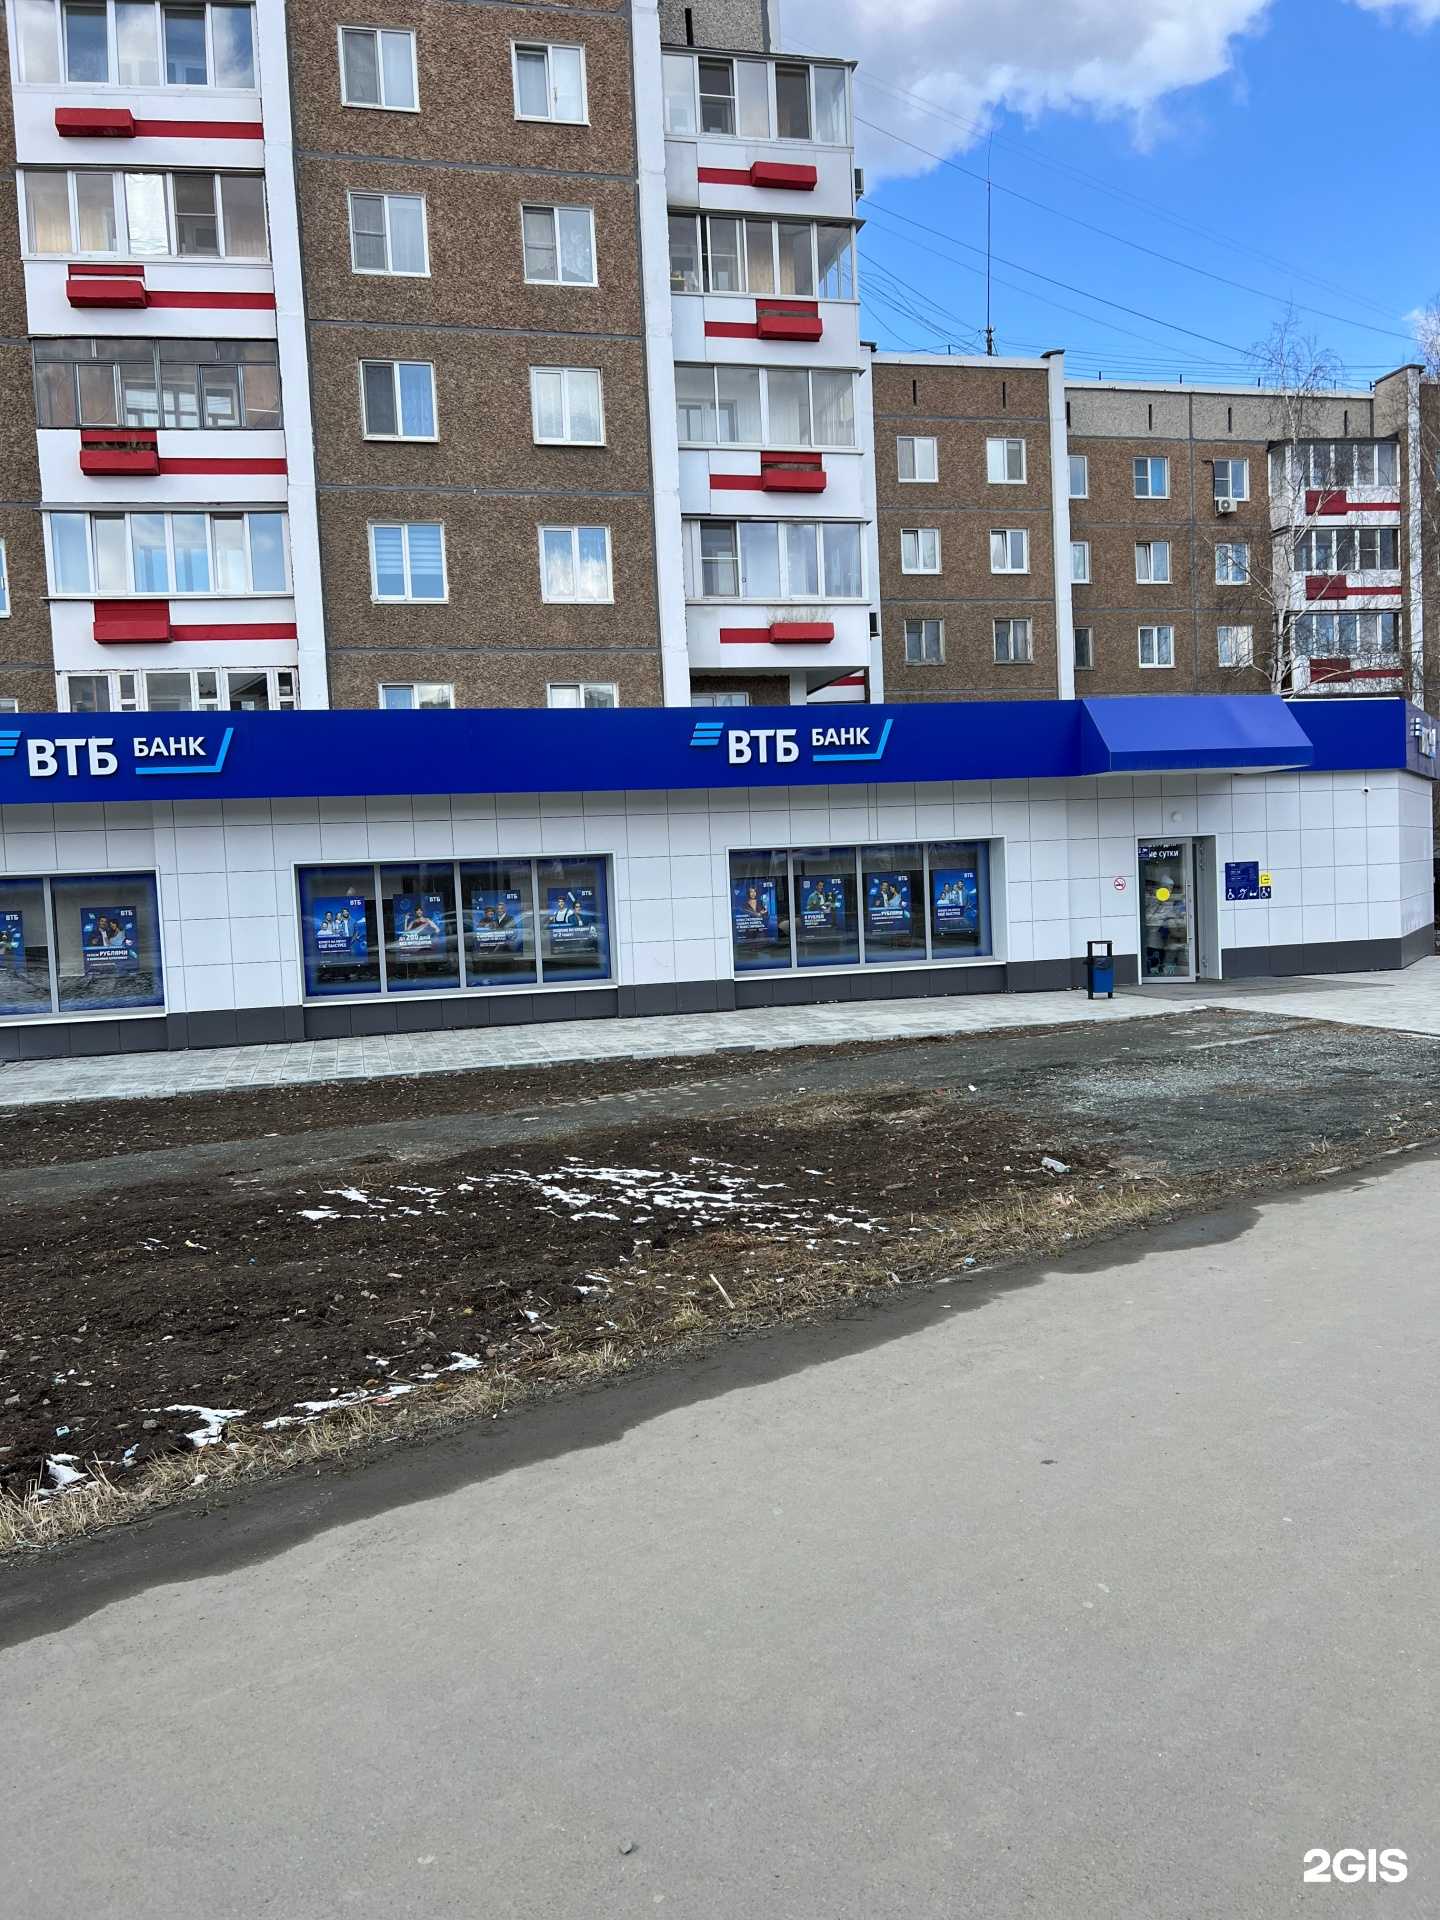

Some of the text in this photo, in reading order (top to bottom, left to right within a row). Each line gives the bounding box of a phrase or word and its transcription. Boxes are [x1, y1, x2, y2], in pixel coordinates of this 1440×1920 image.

[27, 737, 206, 777] ВТБ БАНК
[728, 727, 870, 764] ВТБ БАНК
[1158, 850, 1179, 859] сутки
